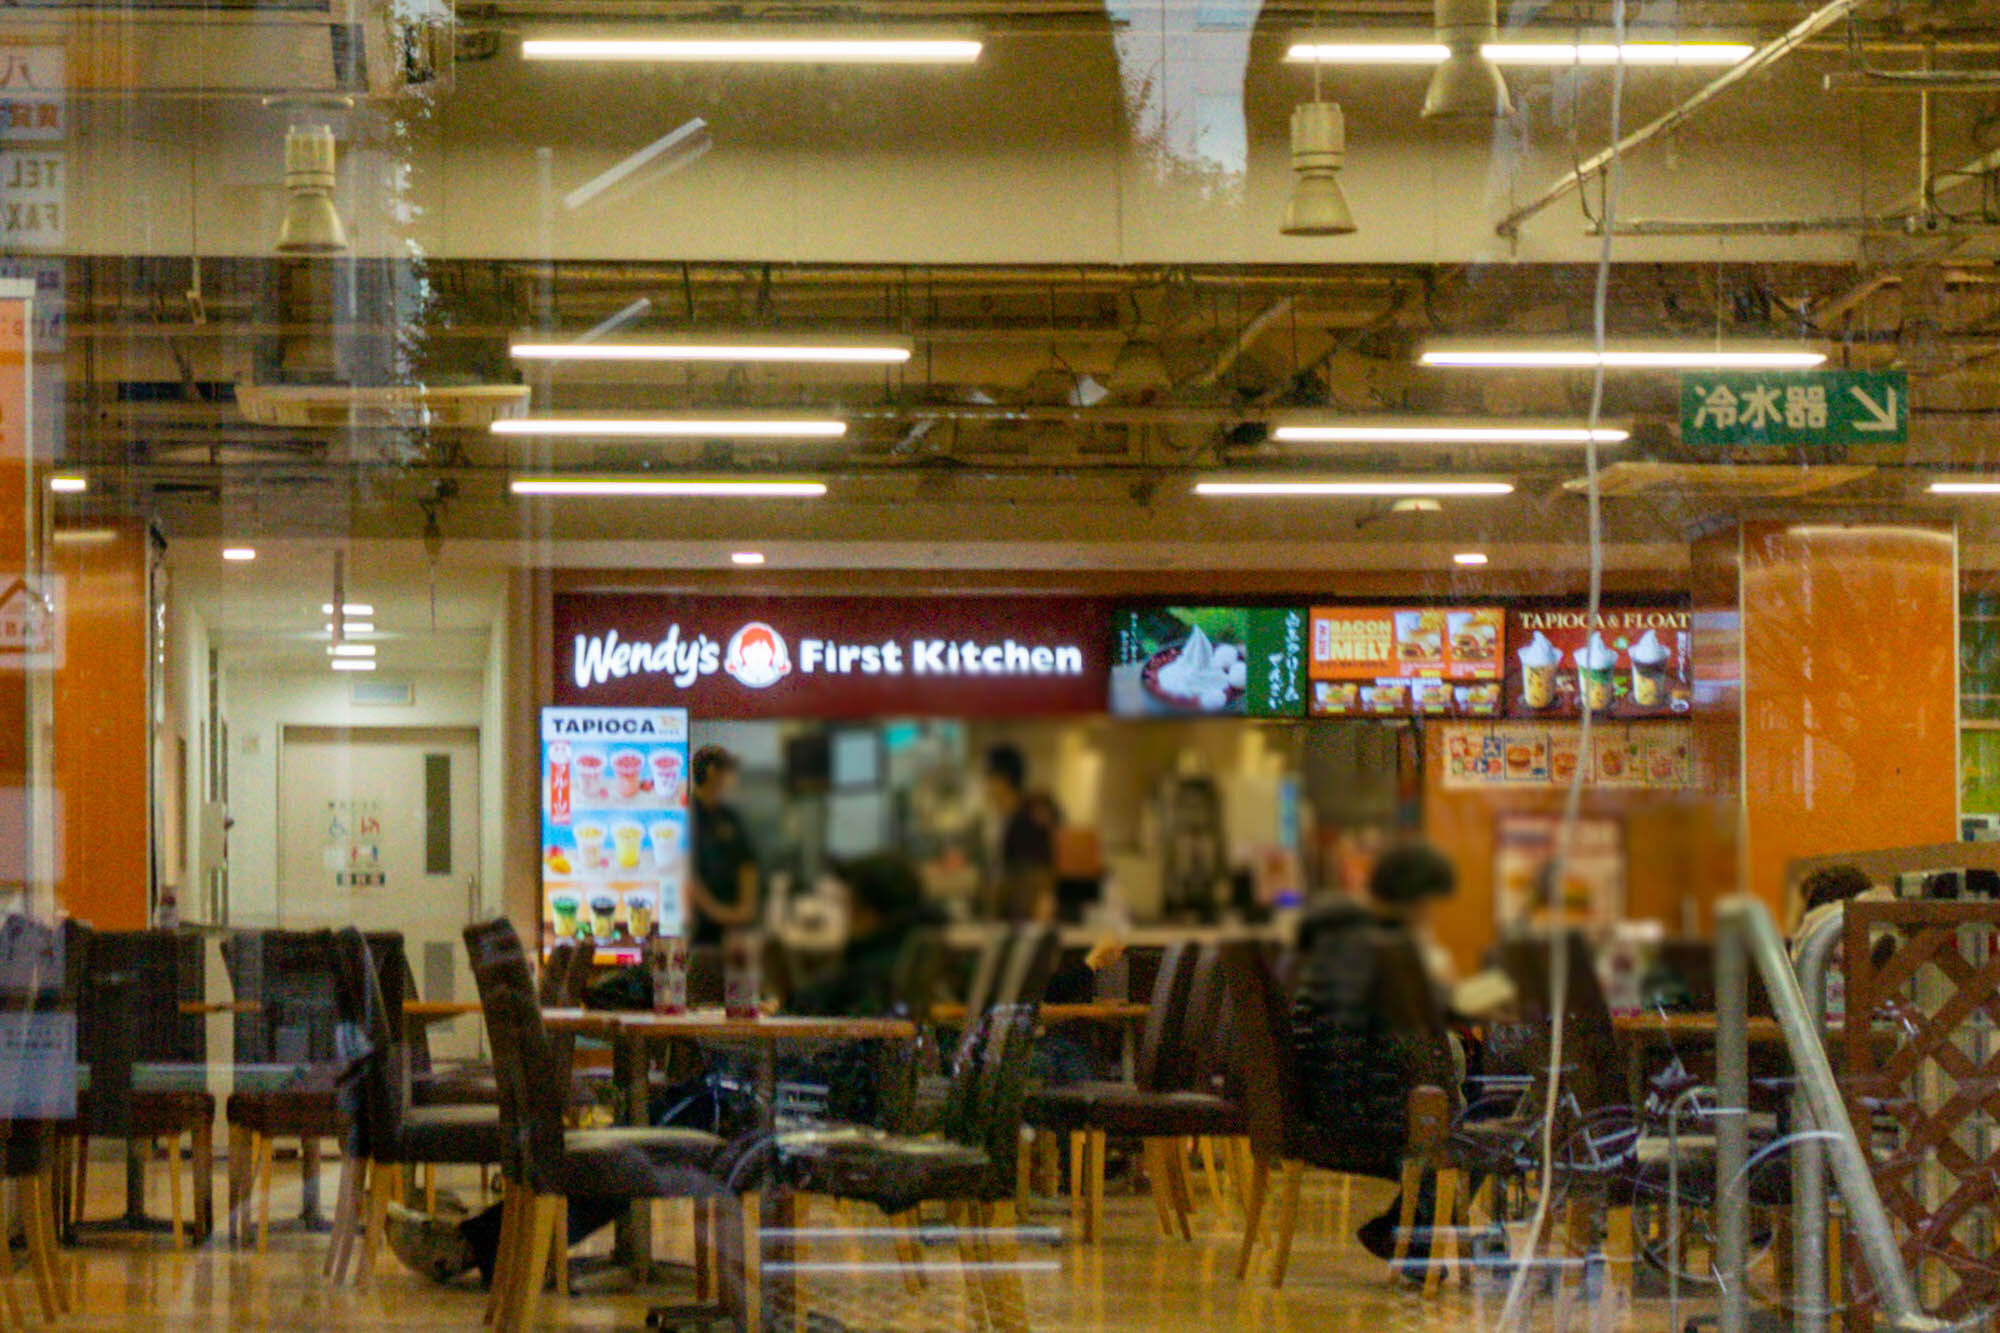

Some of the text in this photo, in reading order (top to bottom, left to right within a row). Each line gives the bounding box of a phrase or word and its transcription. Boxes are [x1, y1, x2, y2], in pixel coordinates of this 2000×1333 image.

[1694, 384, 1829, 430] 冷水器
[1330, 619, 1392, 636] BACON
[1519, 611, 1691, 629] TAPIOCA & FLOAT
[574, 622, 721, 688] Wendy's
[800, 638, 903, 673] First
[912, 638, 1083, 675] Kitchen
[1330, 637, 1391, 661] MELT
[552, 718, 656, 734] TAPIOCA
